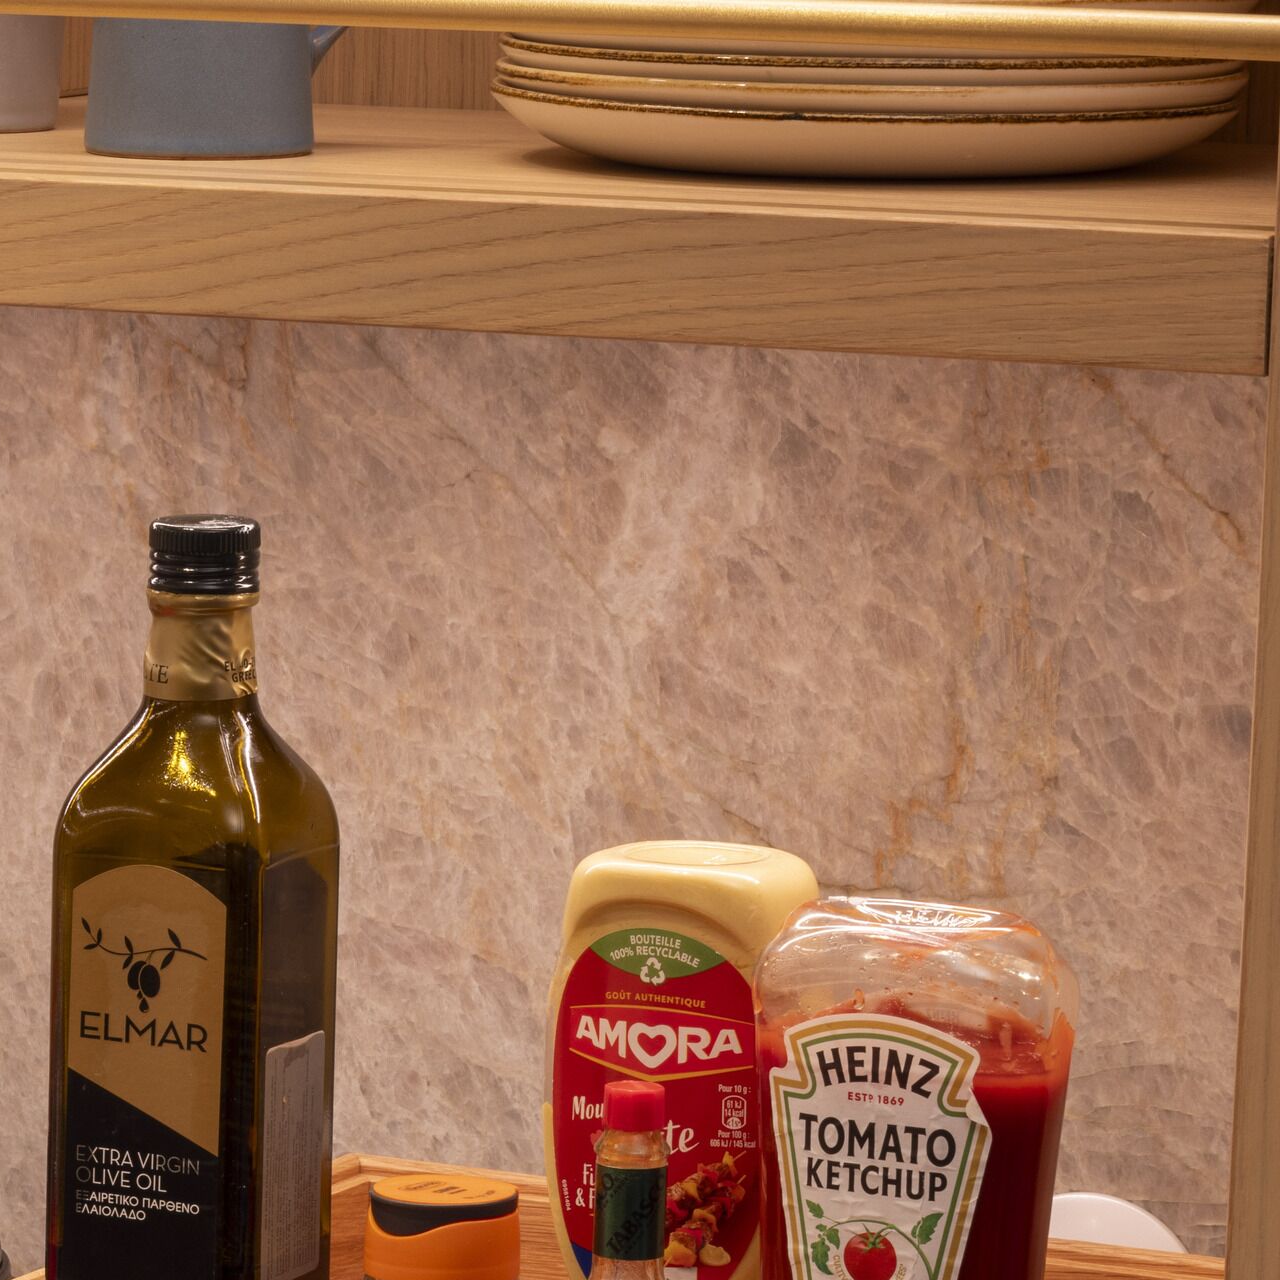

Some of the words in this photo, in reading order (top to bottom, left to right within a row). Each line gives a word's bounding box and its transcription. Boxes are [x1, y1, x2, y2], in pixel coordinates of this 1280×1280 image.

[630, 934, 682, 949] BOUTEILLE
[610, 946, 634, 961] 100%
[636, 945, 701, 968] RECYCLABLE
[605, 989, 632, 1001] GOÛT
[635, 992, 706, 1009] AUTHENTIQUE
[80, 1010, 207, 1053] ELMAR
[576, 1015, 743, 1069] AMORA
[816, 1046, 940, 1099] HEINZ
[718, 1084, 733, 1093] Pour
[734, 1085, 742, 1093] 10
[877, 1095, 905, 1107] 1869
[571, 1095, 604, 1120] Mou
[724, 1109, 731, 1117] 14
[732, 1109, 744, 1117] kcal
[727, 1100, 733, 1108] 61
[661, 1119, 700, 1155] te
[731, 1130, 742, 1139] 100
[799, 1112, 957, 1168] TOMATO
[76, 1144, 134, 1168] EXTRA
[137, 1151, 200, 1175] VIRGIN
[76, 1165, 132, 1188] OLIVE
[136, 1172, 167, 1193] OIL
[806, 1156, 948, 1202] KETCHUP
